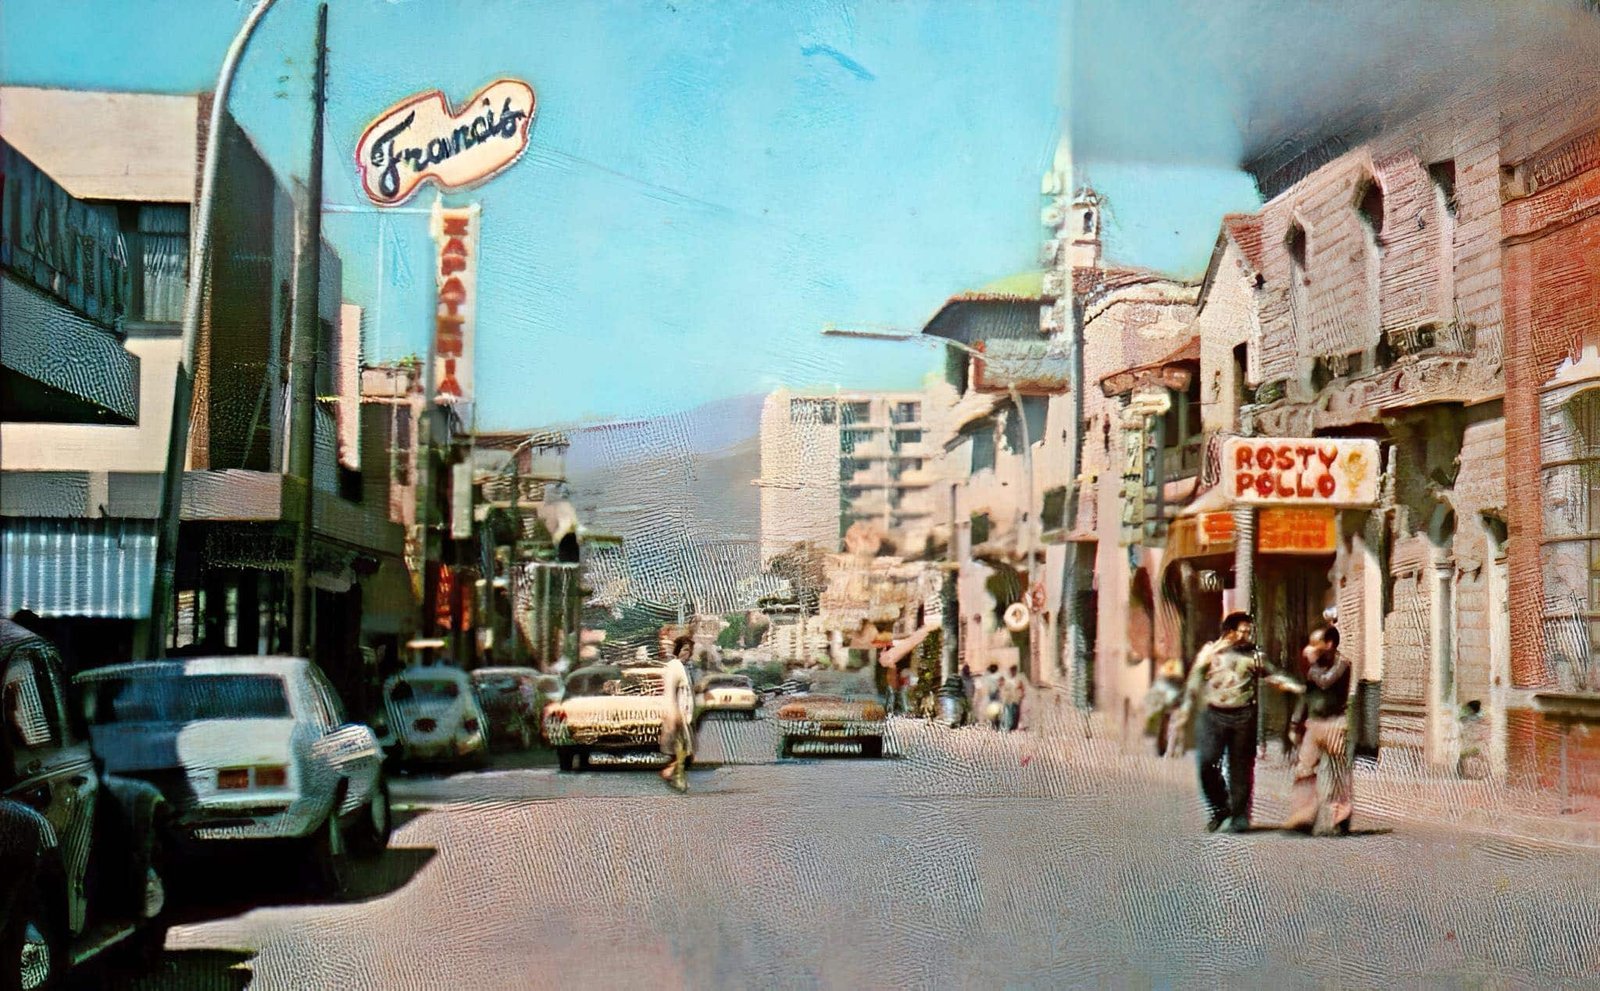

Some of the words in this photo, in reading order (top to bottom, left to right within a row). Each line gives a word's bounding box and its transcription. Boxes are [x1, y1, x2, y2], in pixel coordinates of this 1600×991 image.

[370, 97, 526, 197] Francis
[1235, 445, 1338, 470] ROSTY
[1235, 472, 1336, 498] POLLO
